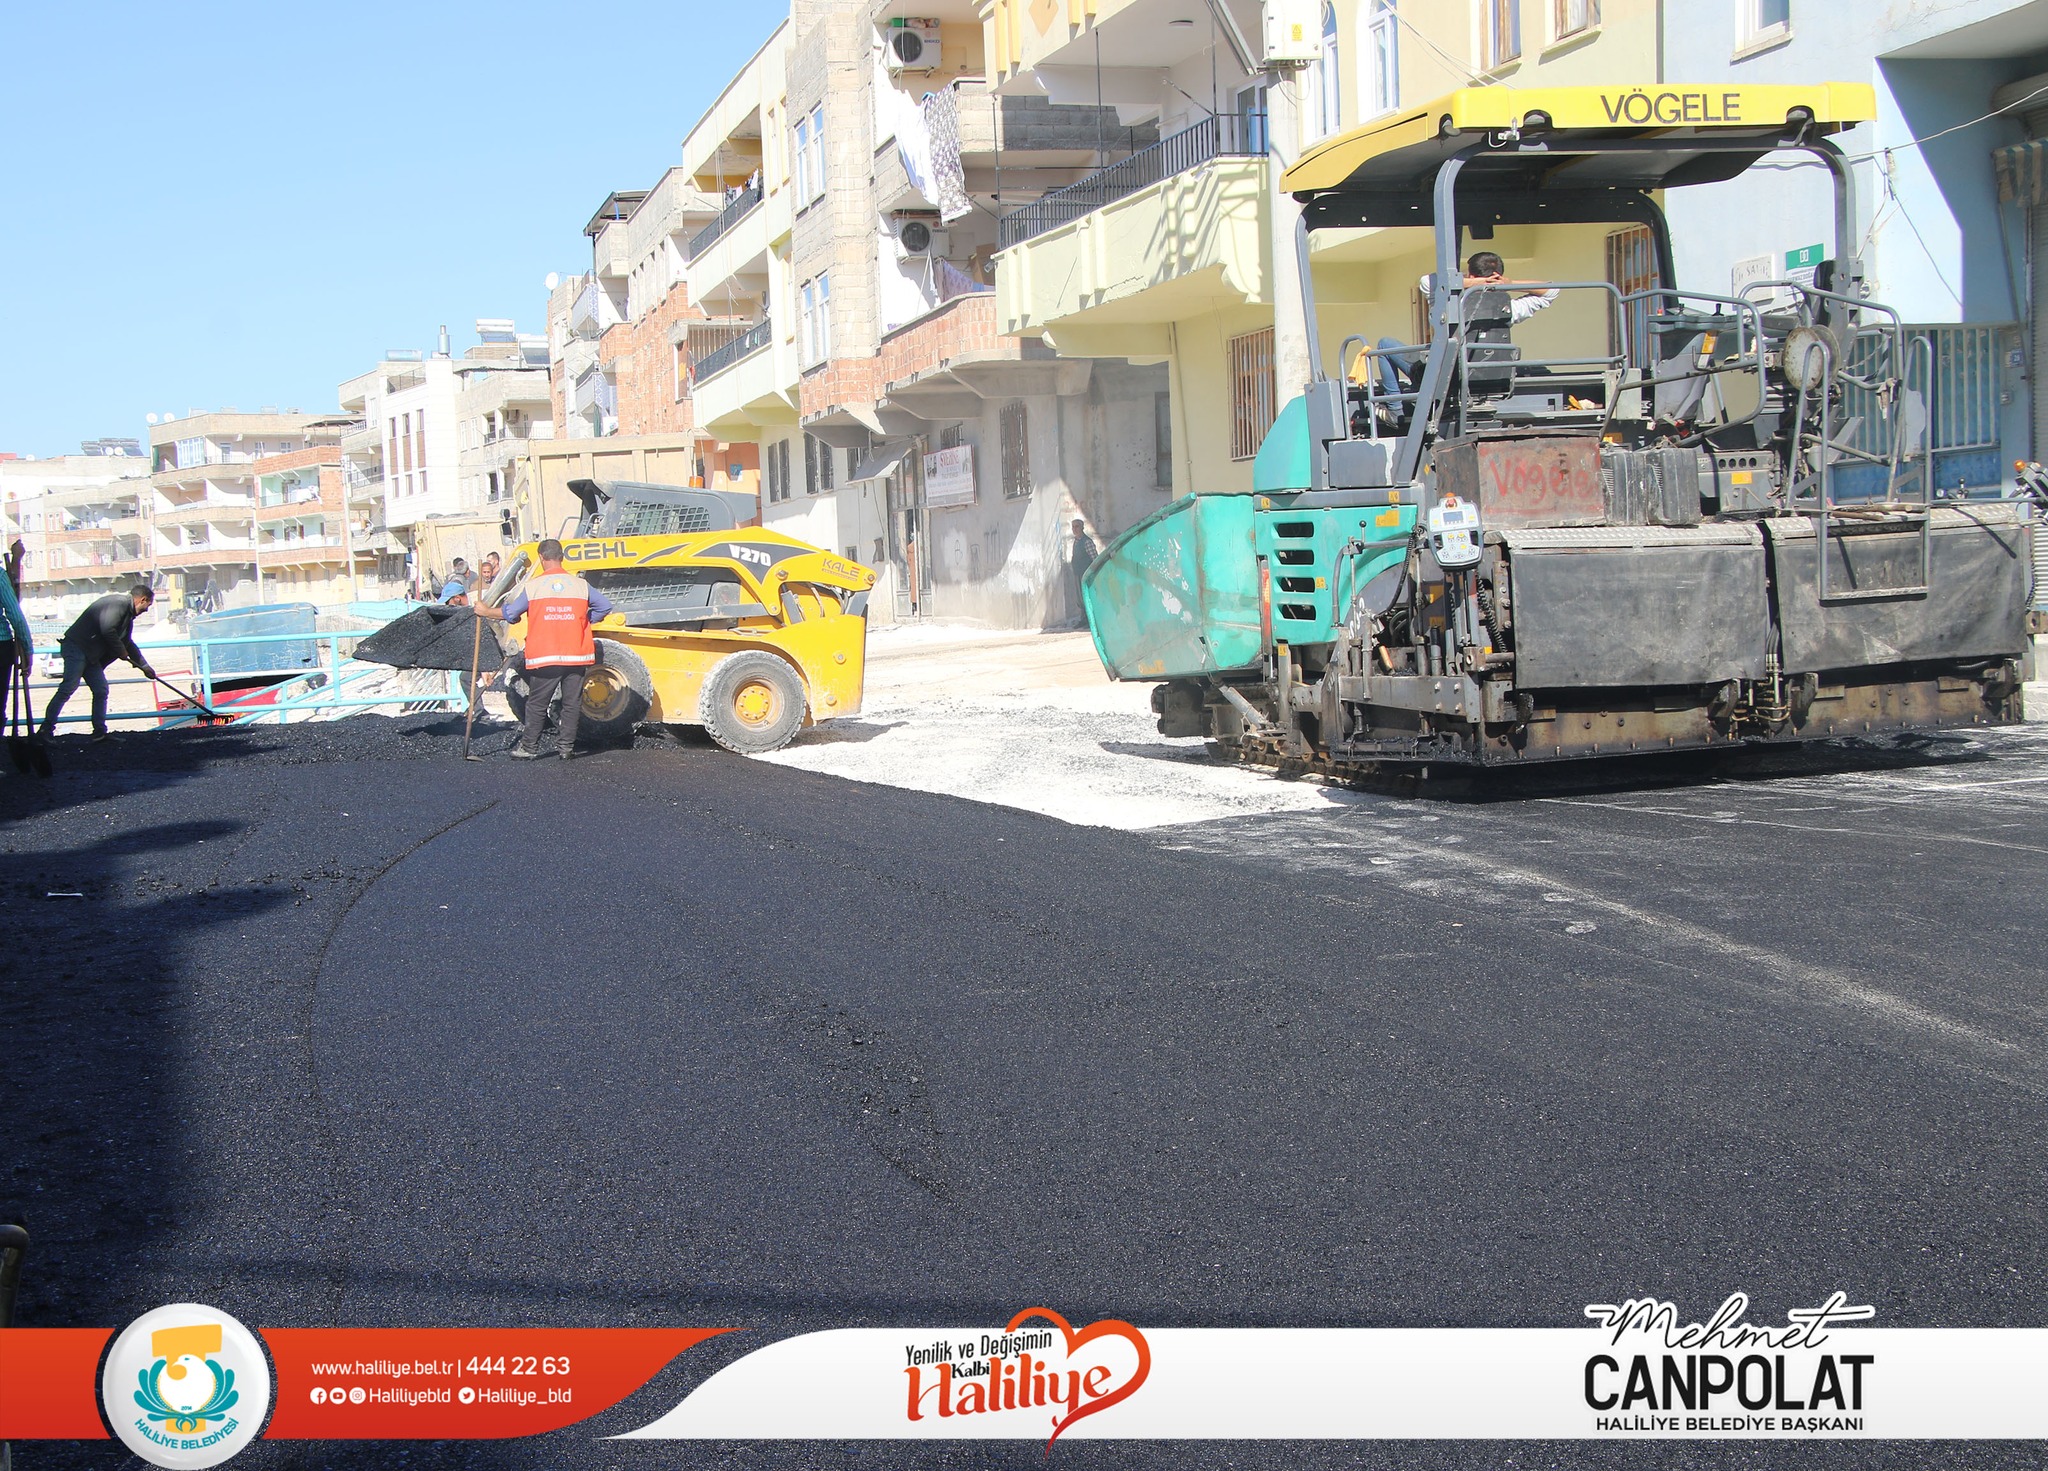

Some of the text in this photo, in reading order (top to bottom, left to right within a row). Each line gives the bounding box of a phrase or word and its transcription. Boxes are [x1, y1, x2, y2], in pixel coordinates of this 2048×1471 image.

[1600, 88, 1741, 124] VÖGELE
[563, 540, 637, 562] GEHL
[729, 544, 771, 566] V270
[822, 558, 860, 577] KALE
